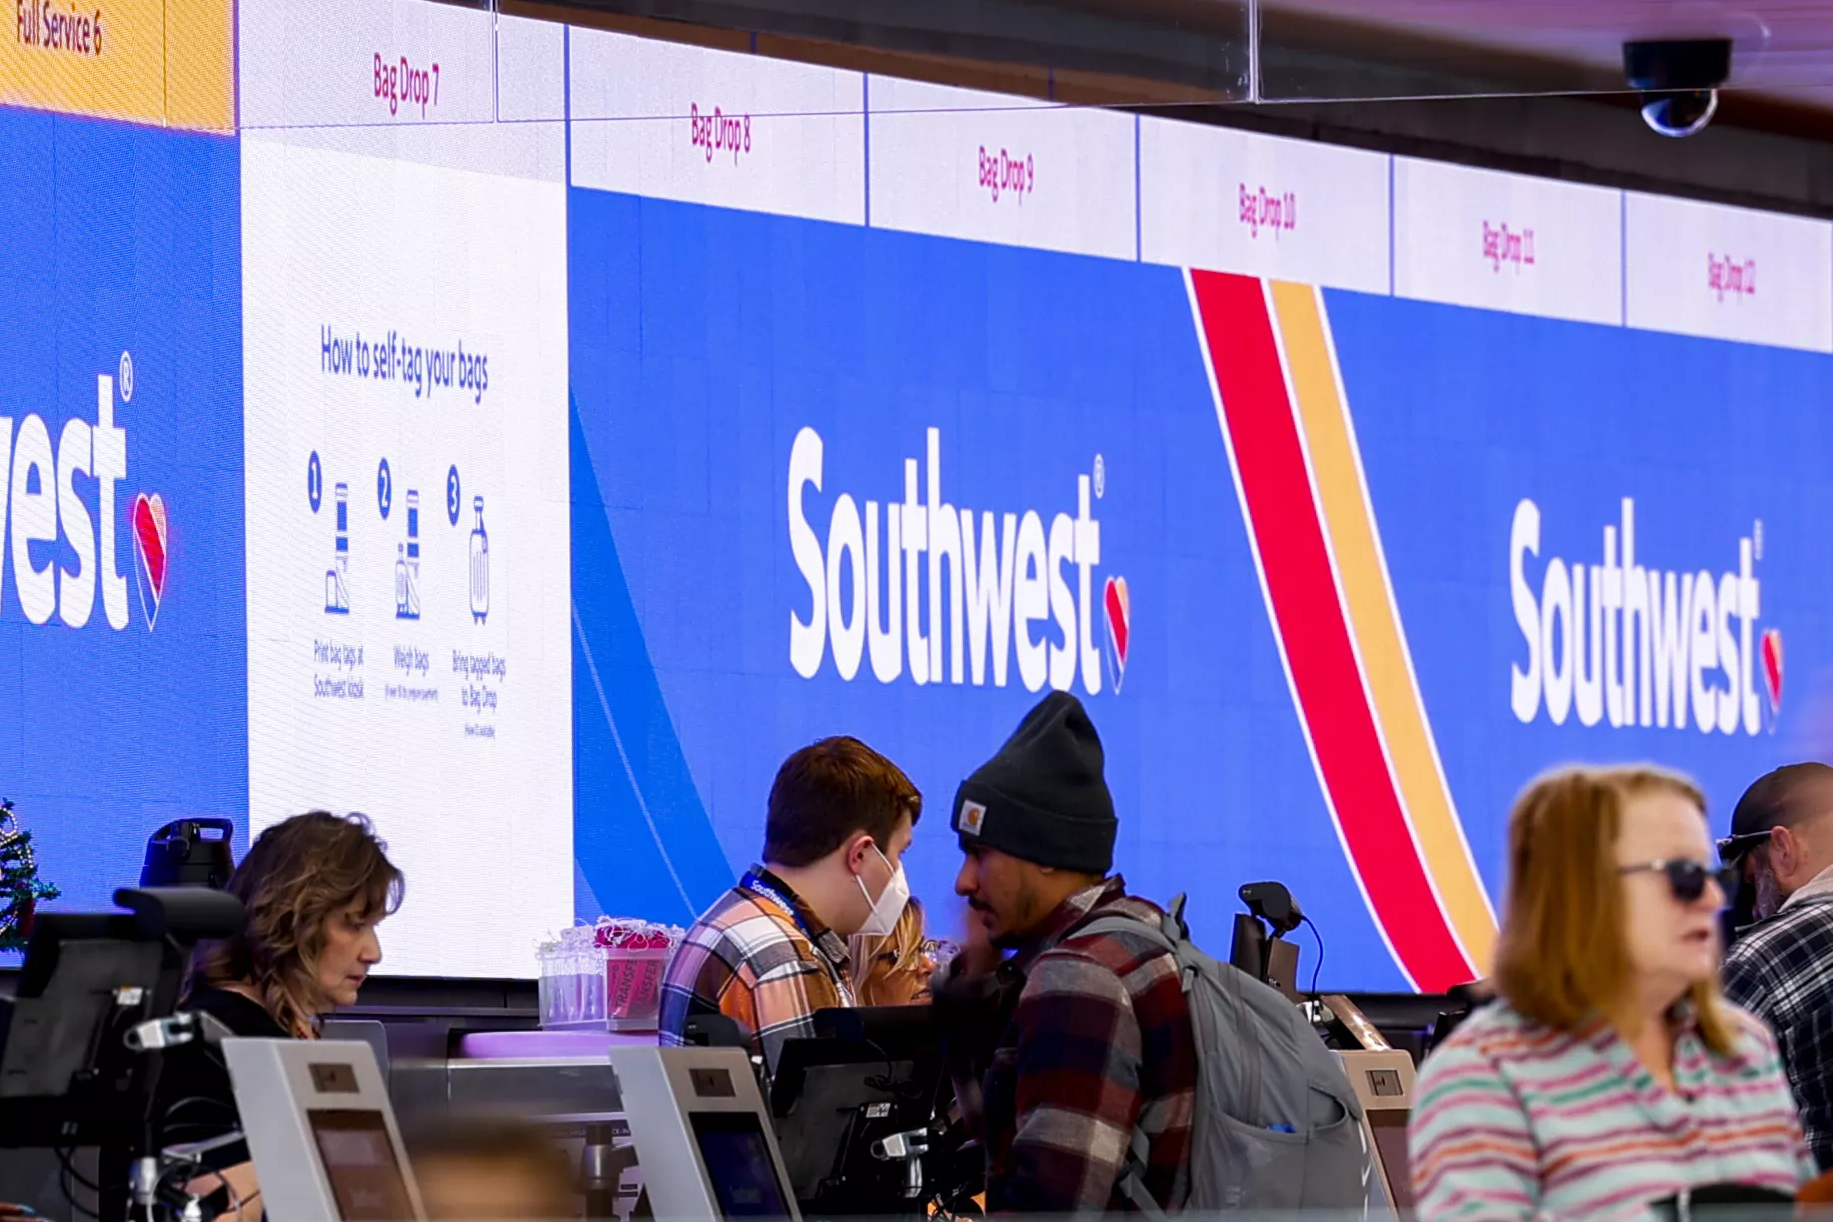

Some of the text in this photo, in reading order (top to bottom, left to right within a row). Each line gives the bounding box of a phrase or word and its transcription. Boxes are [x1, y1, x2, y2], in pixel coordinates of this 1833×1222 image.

[16, 0, 102, 56] Full Service 6
[373, 52, 440, 120] Bag Drop 7
[691, 102, 751, 167] Bag Drop 8
[979, 145, 1034, 206] Bag Drop 9
[1239, 183, 1296, 242] Bag Drop 10
[1482, 220, 1499, 272] Bag
[1500, 223, 1521, 275] Drop
[320, 324, 489, 405] How to self-tag your bags
[788, 426, 1102, 696] Southwest
[1510, 497, 1761, 737] Southwest
[750, 879, 795, 917] Southwest
